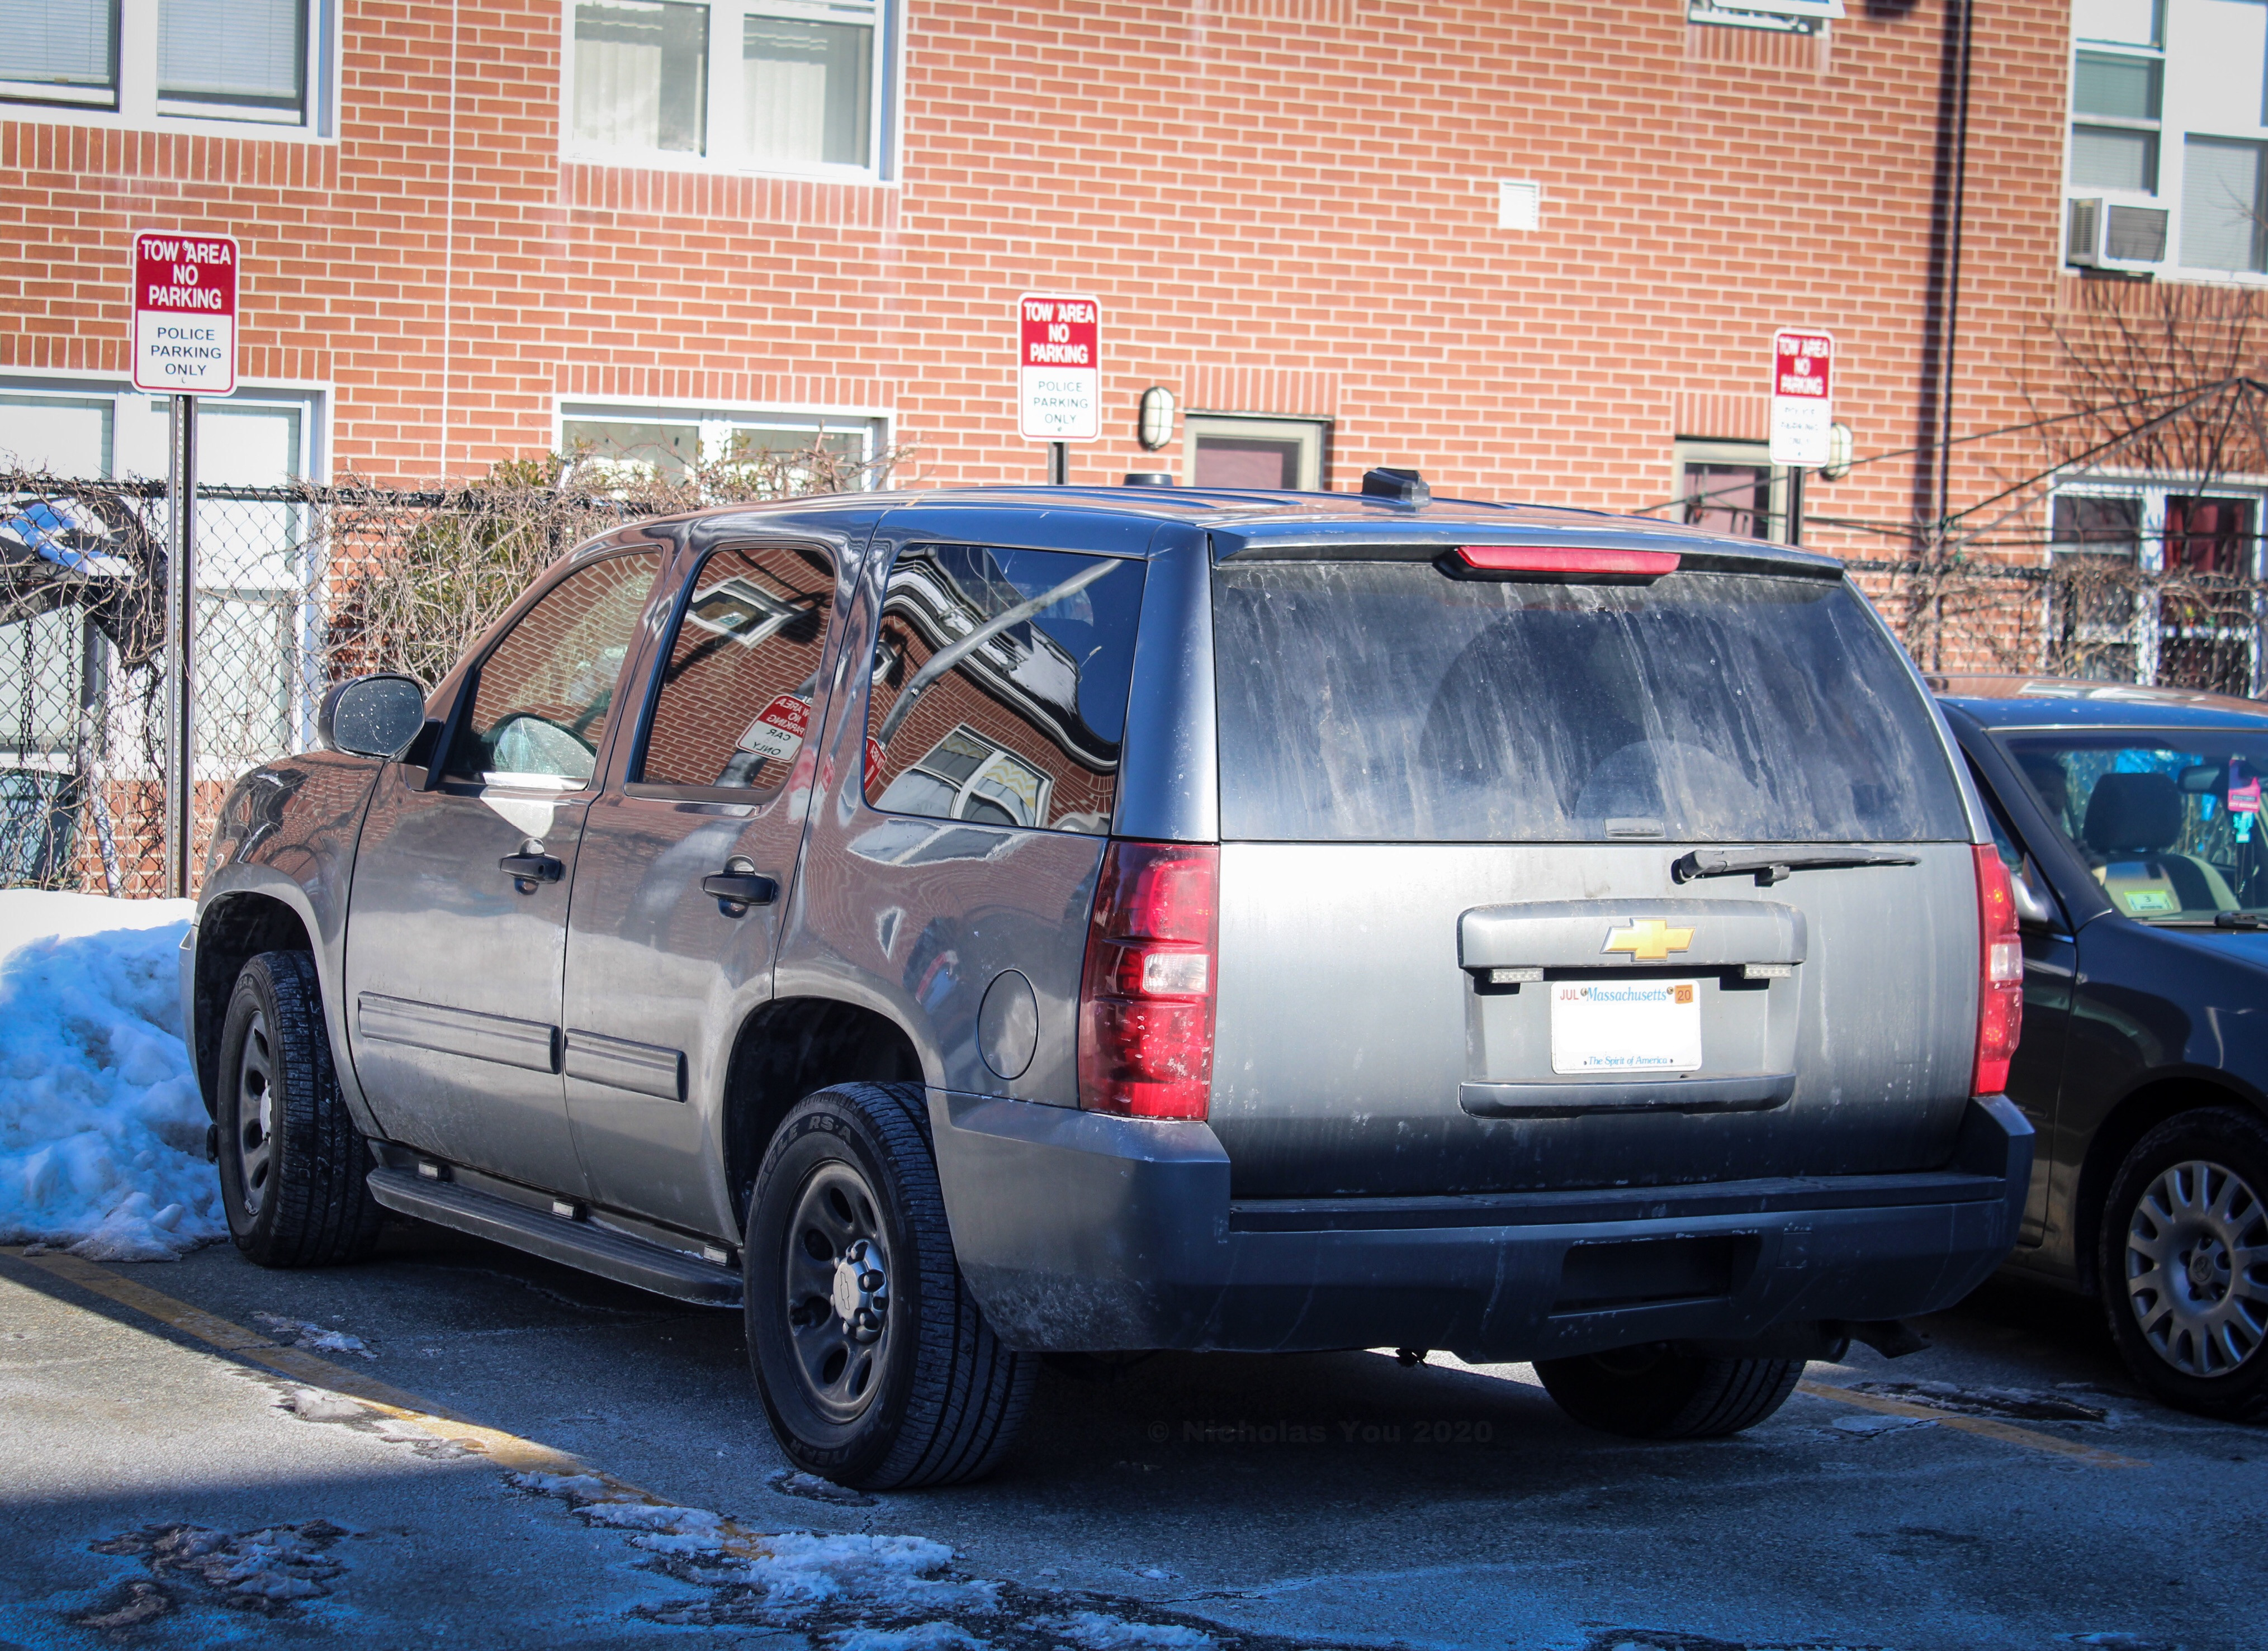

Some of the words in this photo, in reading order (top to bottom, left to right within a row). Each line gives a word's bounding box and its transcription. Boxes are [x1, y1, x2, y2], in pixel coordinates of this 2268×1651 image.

[141, 239, 179, 262] TOW
[185, 242, 231, 265] AREA
[173, 263, 198, 286] NO
[149, 285, 222, 310] PARKING
[1024, 302, 1054, 322] TOW
[1058, 303, 1096, 324] AREA
[158, 327, 215, 341] POLICE
[1048, 323, 1070, 343] NO
[151, 345, 222, 359] PARKING
[1030, 343, 1089, 364] PARKING
[1778, 337, 1800, 356] TOW
[1801, 339, 1829, 359] AREA
[165, 363, 206, 376] ONLY
[1793, 357, 1811, 376] NO
[1038, 381, 1082, 392] POLICE
[1780, 374, 1824, 396] PARKING
[1034, 397, 1088, 409] PARKING
[1045, 414, 1077, 424] ONLY
[1560, 989, 1579, 1000] JUL
[1586, 986, 1667, 1002] Massachusetts
[1678, 990, 1691, 1001] 20
[1589, 1056, 1604, 1065] The
[1606, 1056, 1625, 1067] Spirit
[1627, 1056, 1635, 1065] of
[1636, 1056, 1667, 1065] America
